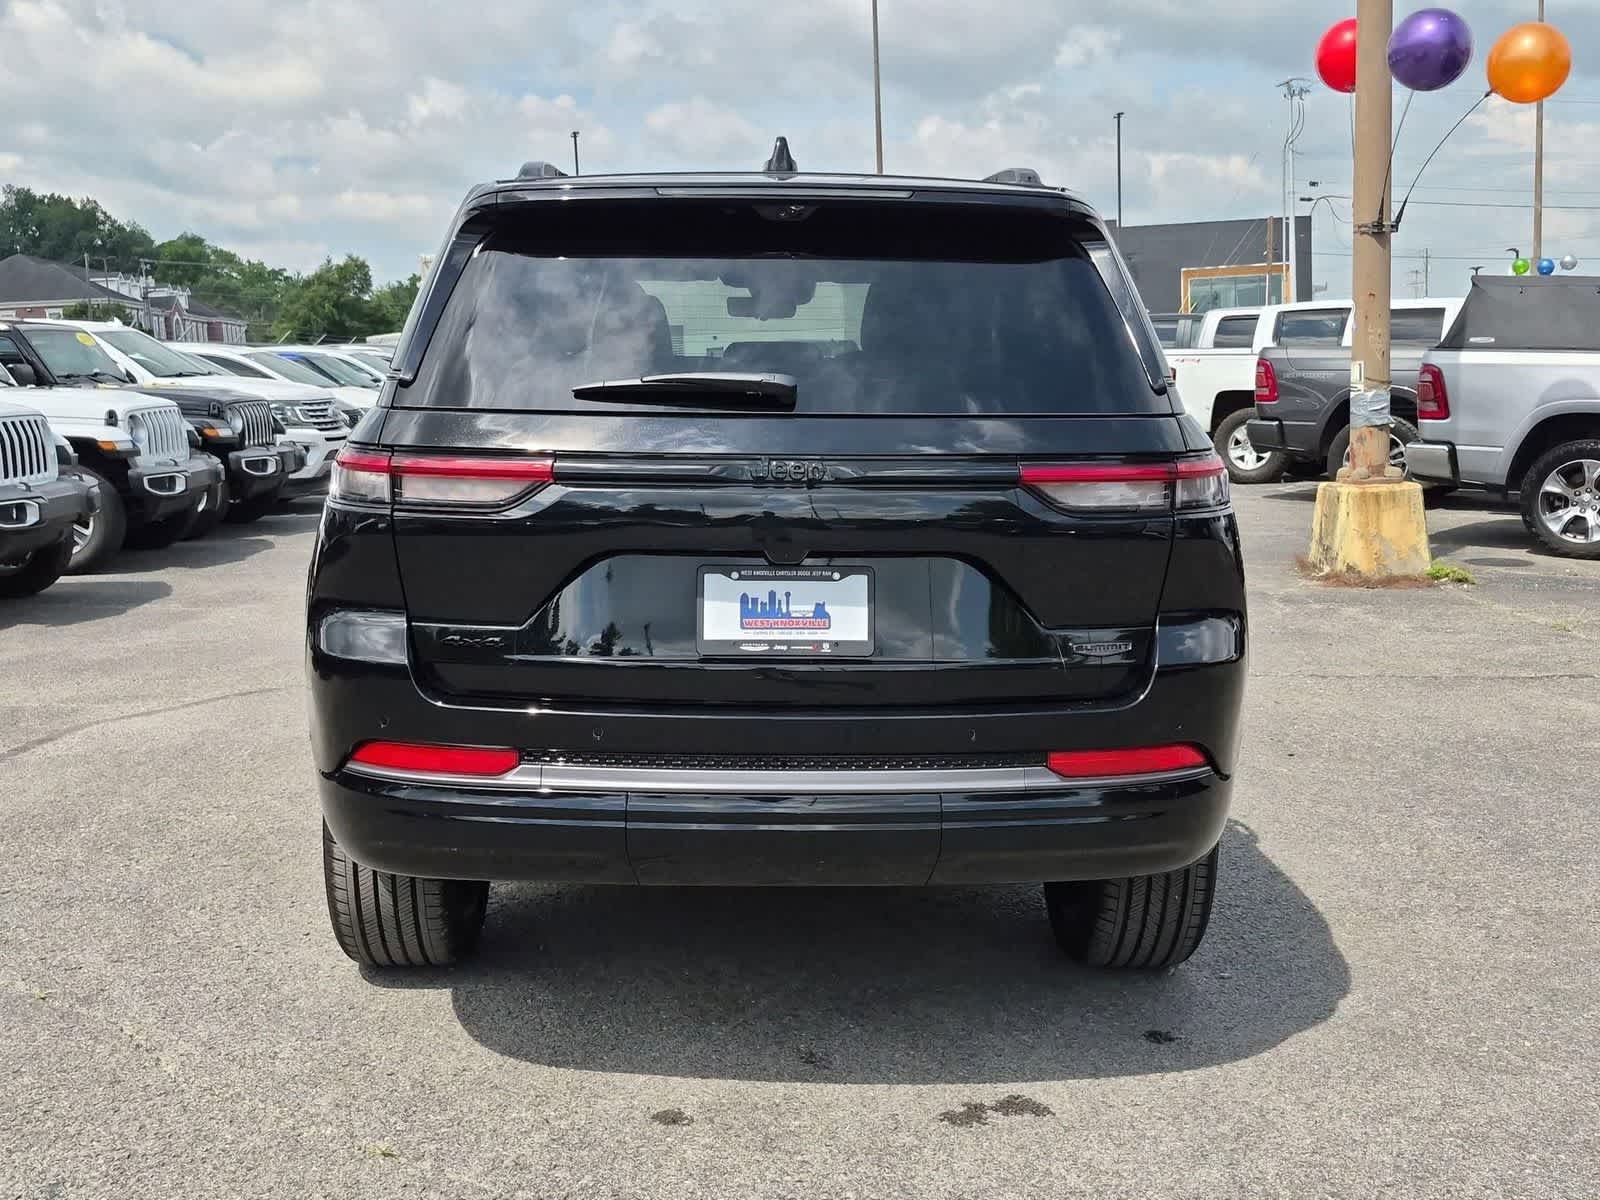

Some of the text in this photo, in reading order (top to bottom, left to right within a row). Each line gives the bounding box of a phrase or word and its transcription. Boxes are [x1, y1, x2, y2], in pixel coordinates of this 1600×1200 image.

[750, 457, 826, 489] Jeep
[744, 619, 827, 628] WEST KNOXVILLE
